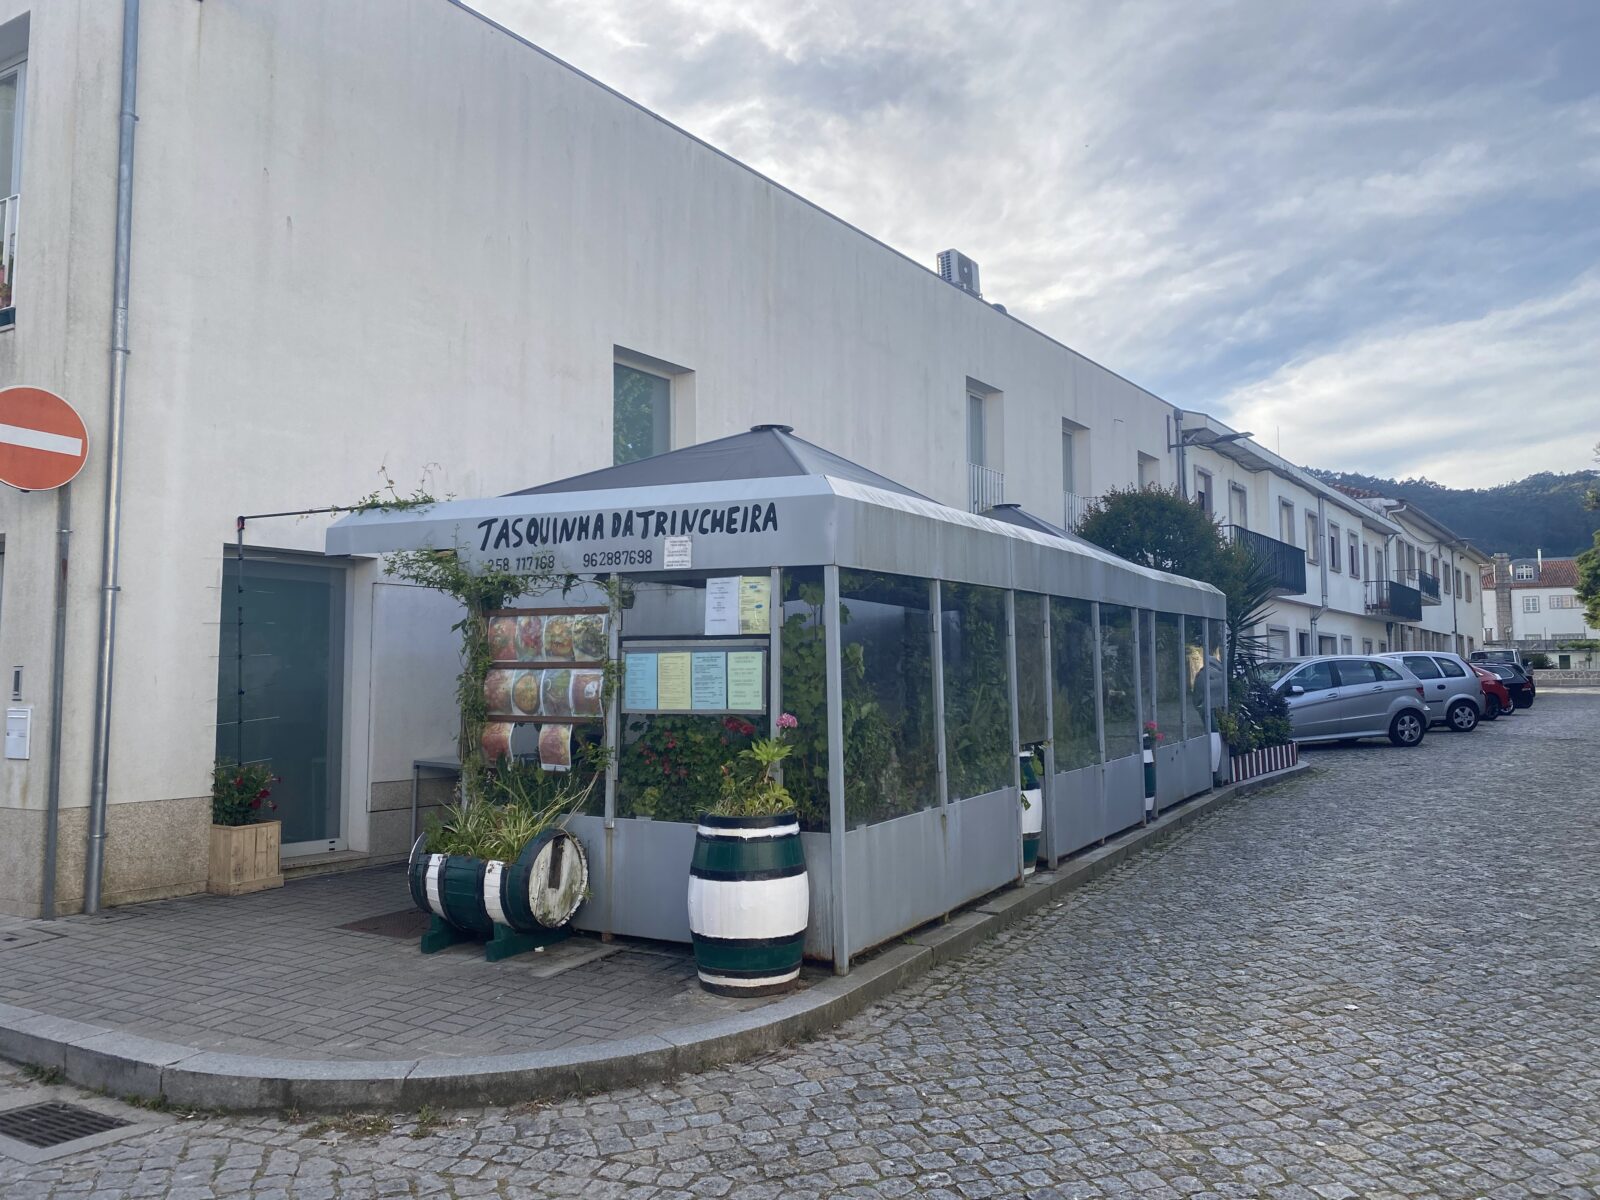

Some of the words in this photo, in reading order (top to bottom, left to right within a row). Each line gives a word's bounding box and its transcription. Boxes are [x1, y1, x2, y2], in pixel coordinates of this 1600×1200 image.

[477, 511, 605, 551] TASQUINHA
[487, 557, 510, 573] 258
[583, 549, 653, 568] 962887698
